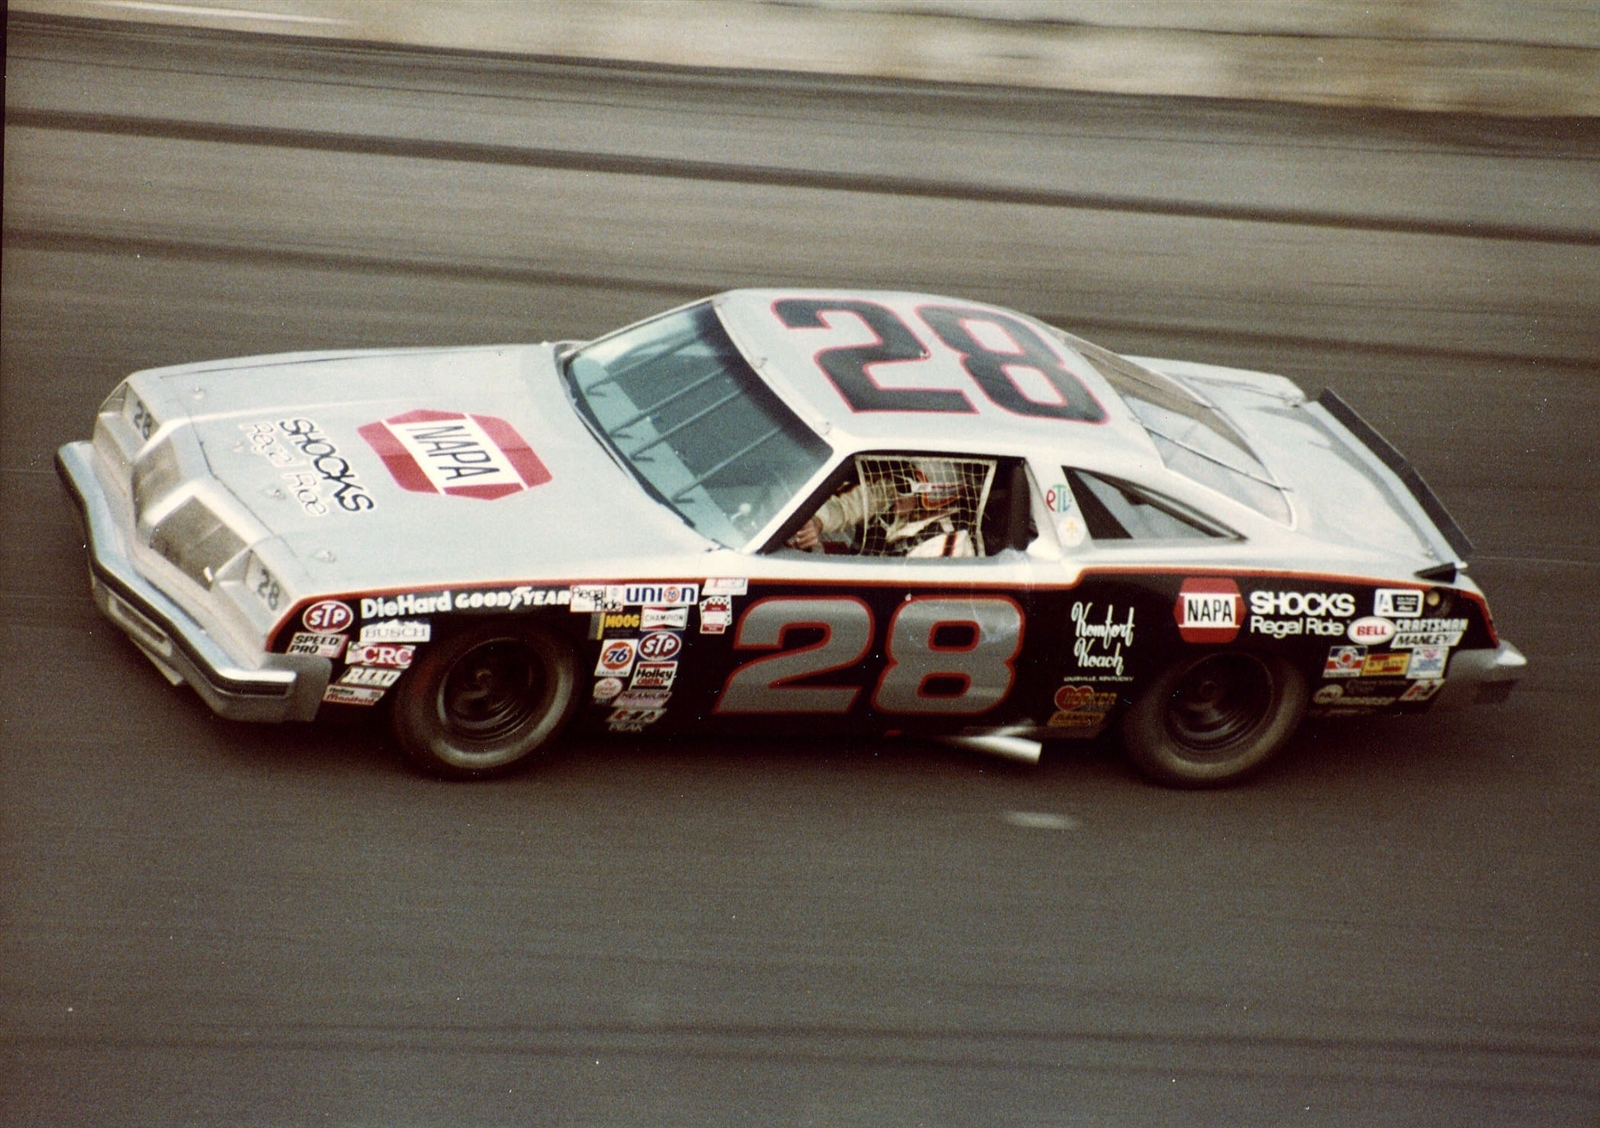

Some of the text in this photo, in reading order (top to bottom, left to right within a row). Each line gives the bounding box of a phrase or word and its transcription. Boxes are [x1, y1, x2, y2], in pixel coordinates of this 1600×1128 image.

[770, 297, 1111, 426] 28
[134, 401, 152, 441] 28
[406, 425, 501, 480] NAPA
[278, 417, 376, 512] SHOCKS
[257, 568, 281, 611] 28
[455, 586, 571, 611] GOODYEAR
[572, 586, 607, 604] Regal
[361, 590, 452, 619] DieHard
[594, 599, 622, 611] Ride
[1187, 599, 1233, 622] NAPA
[1250, 590, 1356, 617] SHOCKS
[309, 604, 346, 627] STP
[605, 613, 640, 628] MOOG
[645, 613, 683, 622] CHAMPION
[1071, 601, 1135, 649] Komfort
[1396, 618, 1468, 632] CRAFTSMAN
[365, 627, 425, 638] BUSCH
[1250, 616, 1345, 639] Regal Ride
[1356, 625, 1387, 636] BELL
[290, 645, 319, 653] PRO
[294, 635, 340, 645] SPEED
[643, 634, 676, 655] STP
[362, 646, 413, 666] CRC
[606, 648, 629, 664] 76
[711, 594, 1025, 716] 28
[1074, 637, 1124, 676] Koach
[636, 669, 673, 681] Holley
